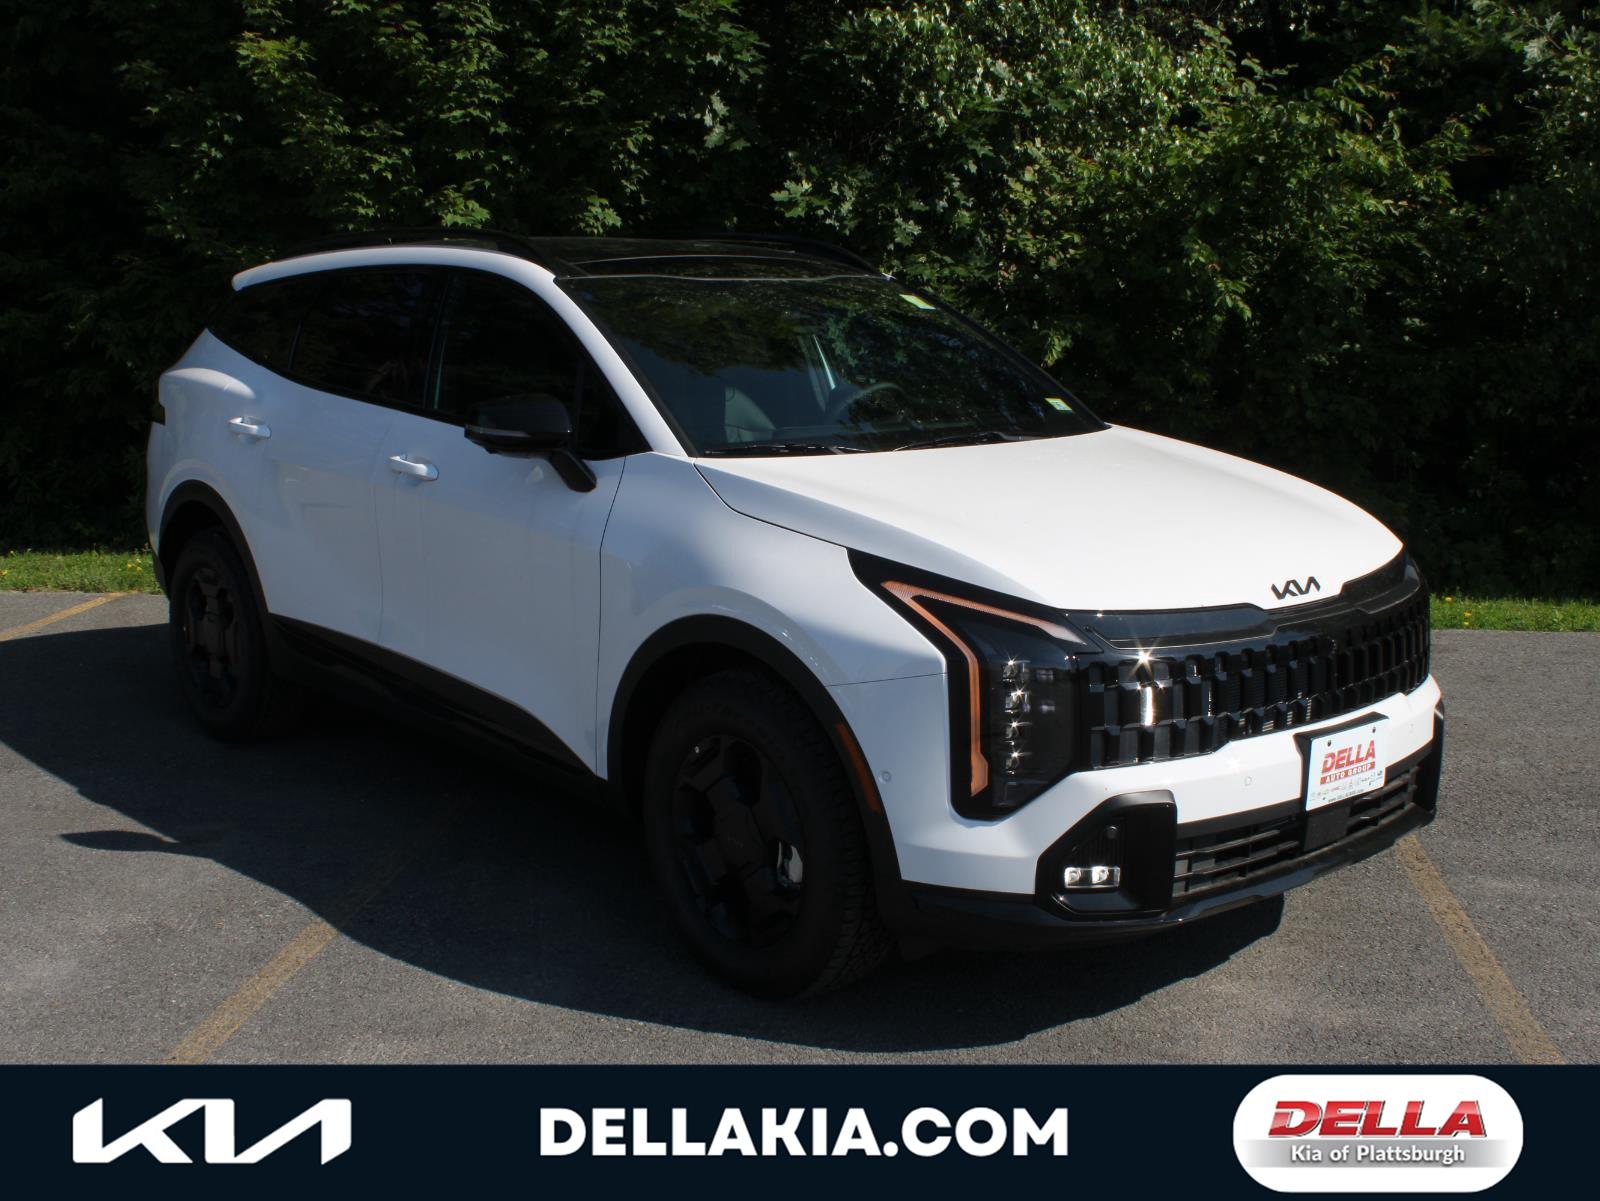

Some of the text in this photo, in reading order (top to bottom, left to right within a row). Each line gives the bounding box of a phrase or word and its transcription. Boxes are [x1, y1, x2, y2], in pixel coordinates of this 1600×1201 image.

[1271, 576, 1320, 600] KIA
[1321, 740, 1375, 773] DELLA
[1325, 764, 1371, 782] AUTO GROUP
